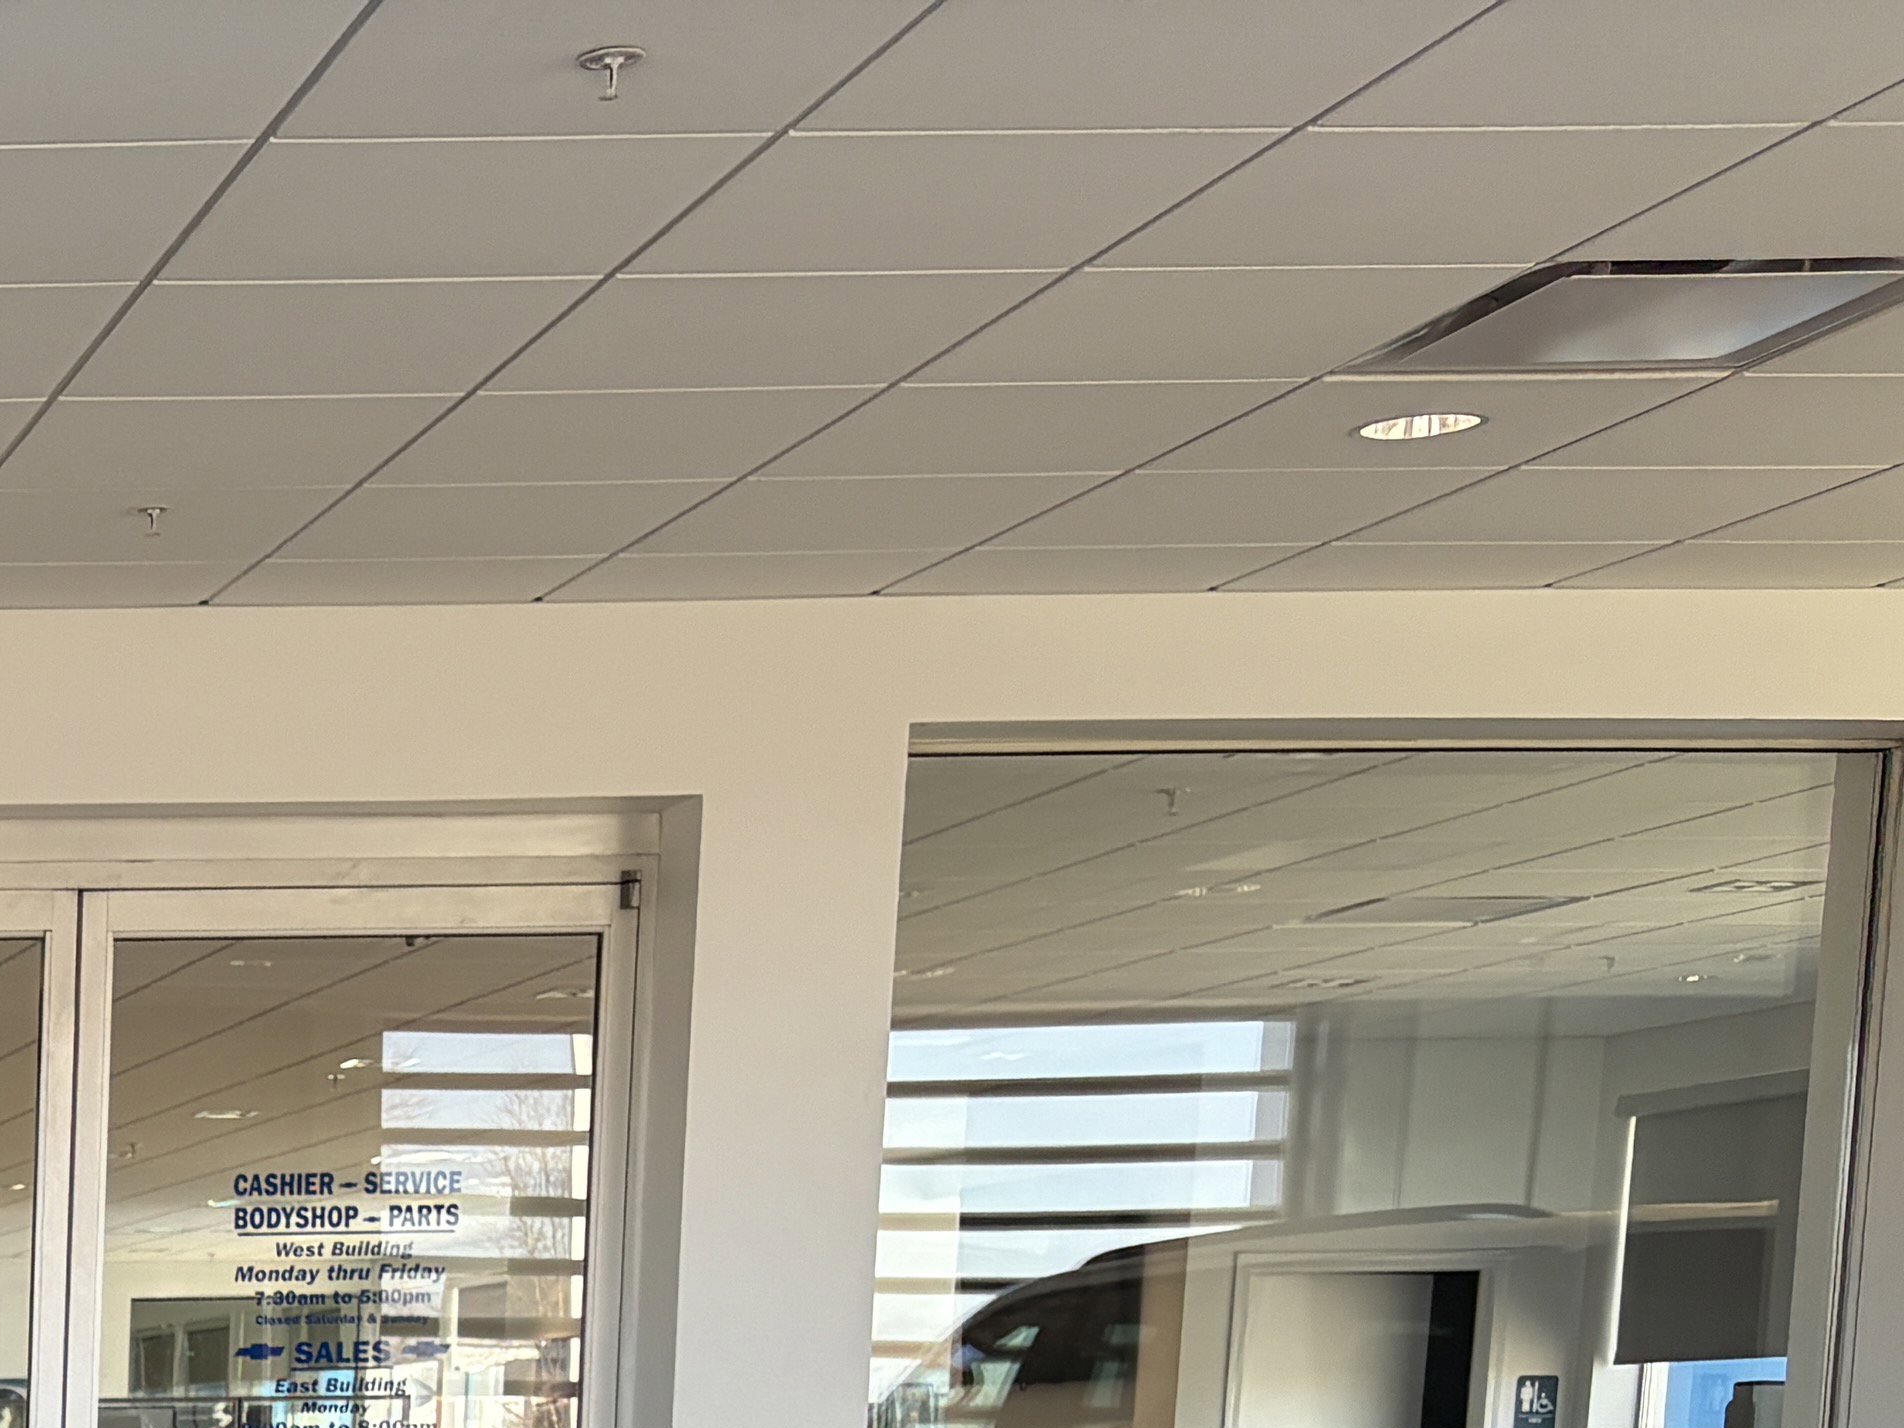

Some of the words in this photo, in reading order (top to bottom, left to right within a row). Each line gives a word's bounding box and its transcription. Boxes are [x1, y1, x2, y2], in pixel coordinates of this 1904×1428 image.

[234, 1173, 334, 1197] CASHIER
[364, 1171, 462, 1195] SERVICE
[234, 1206, 358, 1229] BODYSHOP
[389, 1204, 459, 1227] PARTS
[276, 1242, 324, 1258] West
[331, 1241, 414, 1260] Building
[235, 1265, 320, 1285] Monday
[327, 1264, 370, 1281] thru
[378, 1263, 446, 1284] Friday
[255, 1290, 326, 1306] 7:30am
[333, 1290, 353, 1306] to
[360, 1289, 431, 1307] 5:00pm
[256, 1315, 300, 1326] Closed
[367, 1313, 378, 1325] &
[294, 1341, 392, 1364] SALES
[275, 1379, 319, 1394] East
[325, 1377, 407, 1396] Building
[301, 1402, 371, 1415] Monday
